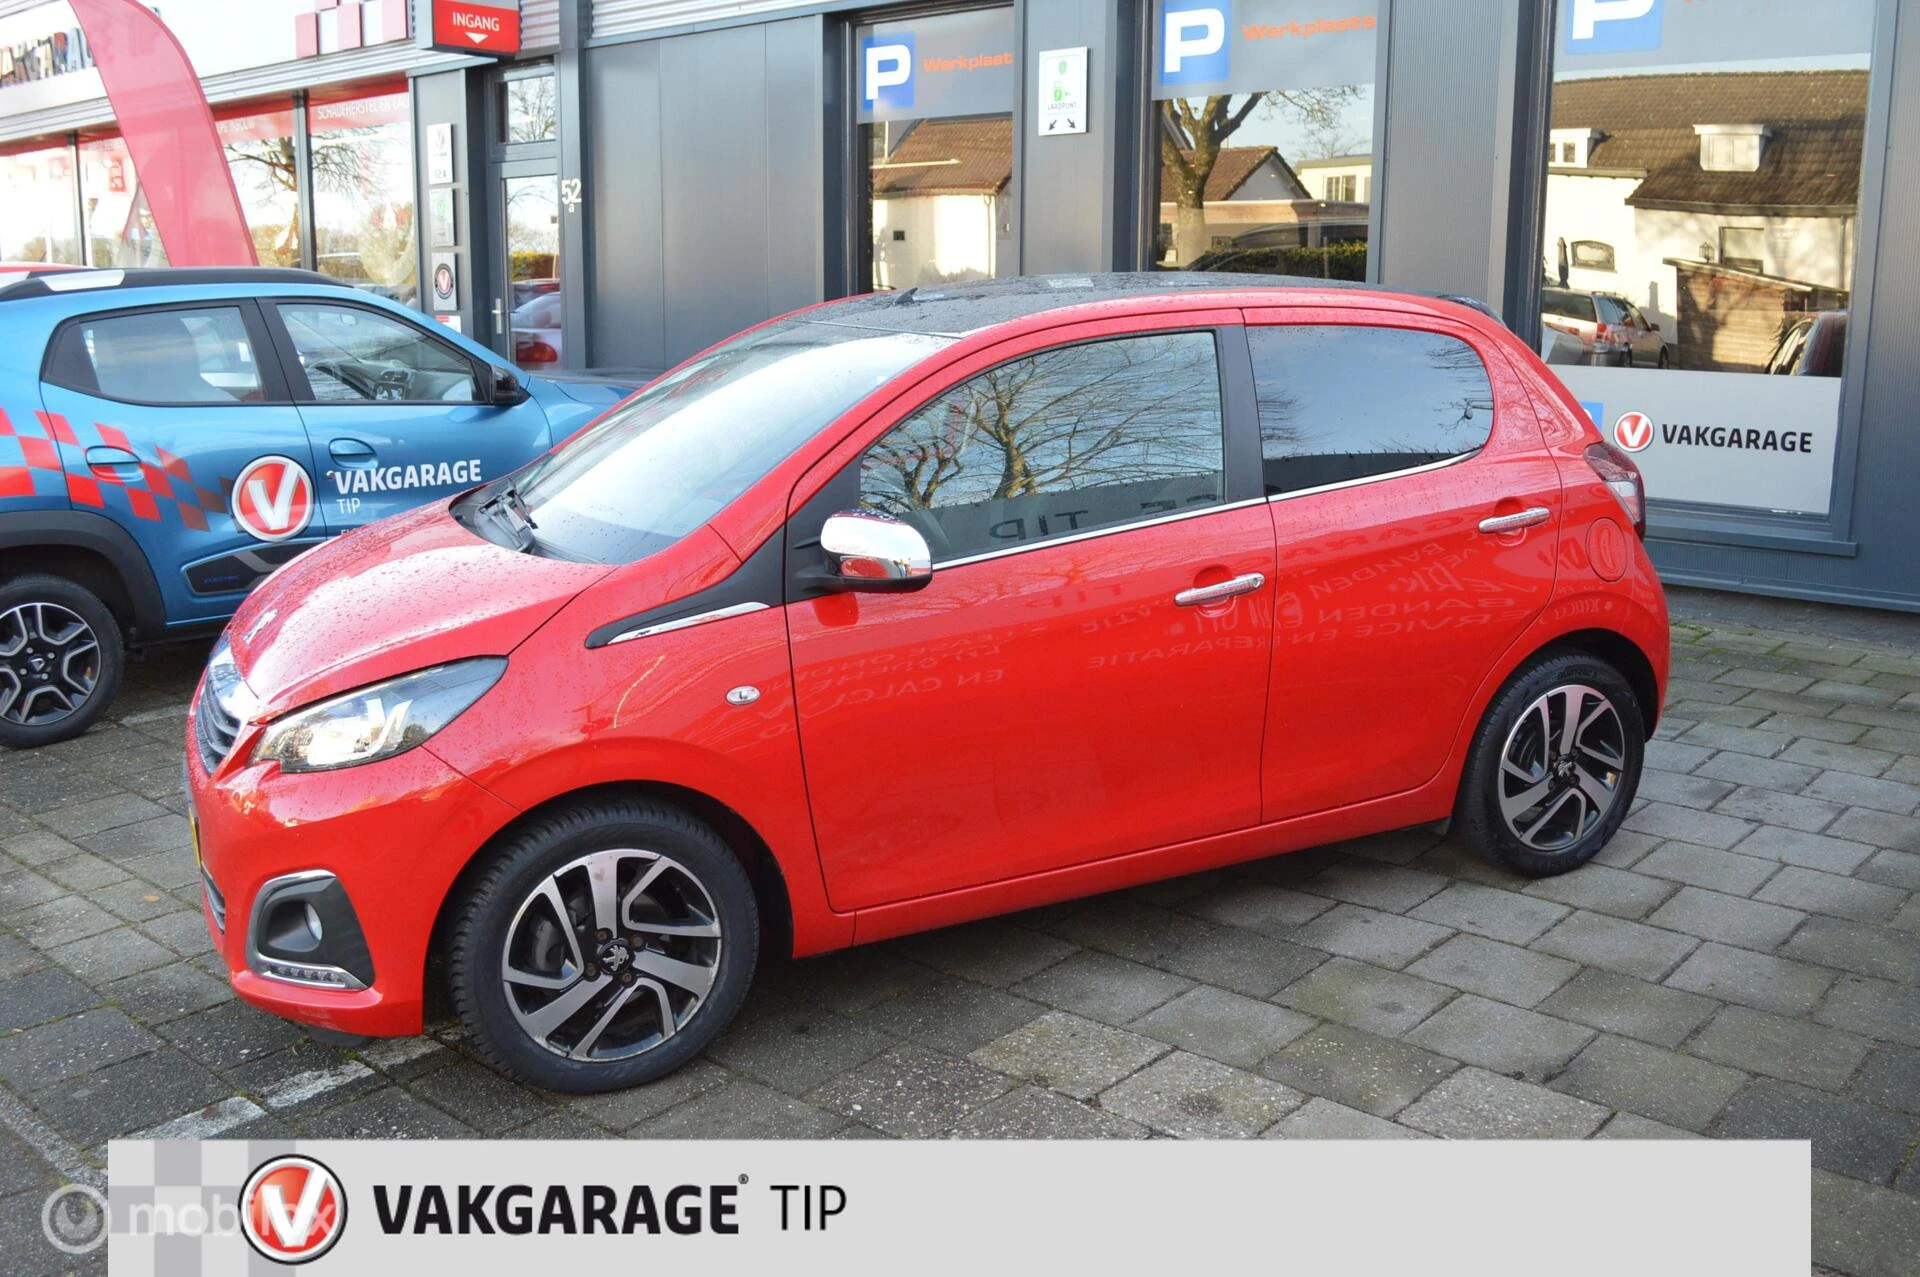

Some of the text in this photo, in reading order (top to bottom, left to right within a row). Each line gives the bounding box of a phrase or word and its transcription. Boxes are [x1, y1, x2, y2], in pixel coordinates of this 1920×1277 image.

[452, 11, 500, 32] INGANG
[1164, 8, 1377, 73] P Werkplaats
[865, 44, 912, 101] P
[561, 178, 582, 205] 52
[1662, 423, 1813, 453] VAKGARAGE
[335, 459, 482, 494] VAKGARAGE
[336, 497, 361, 514] TIP
